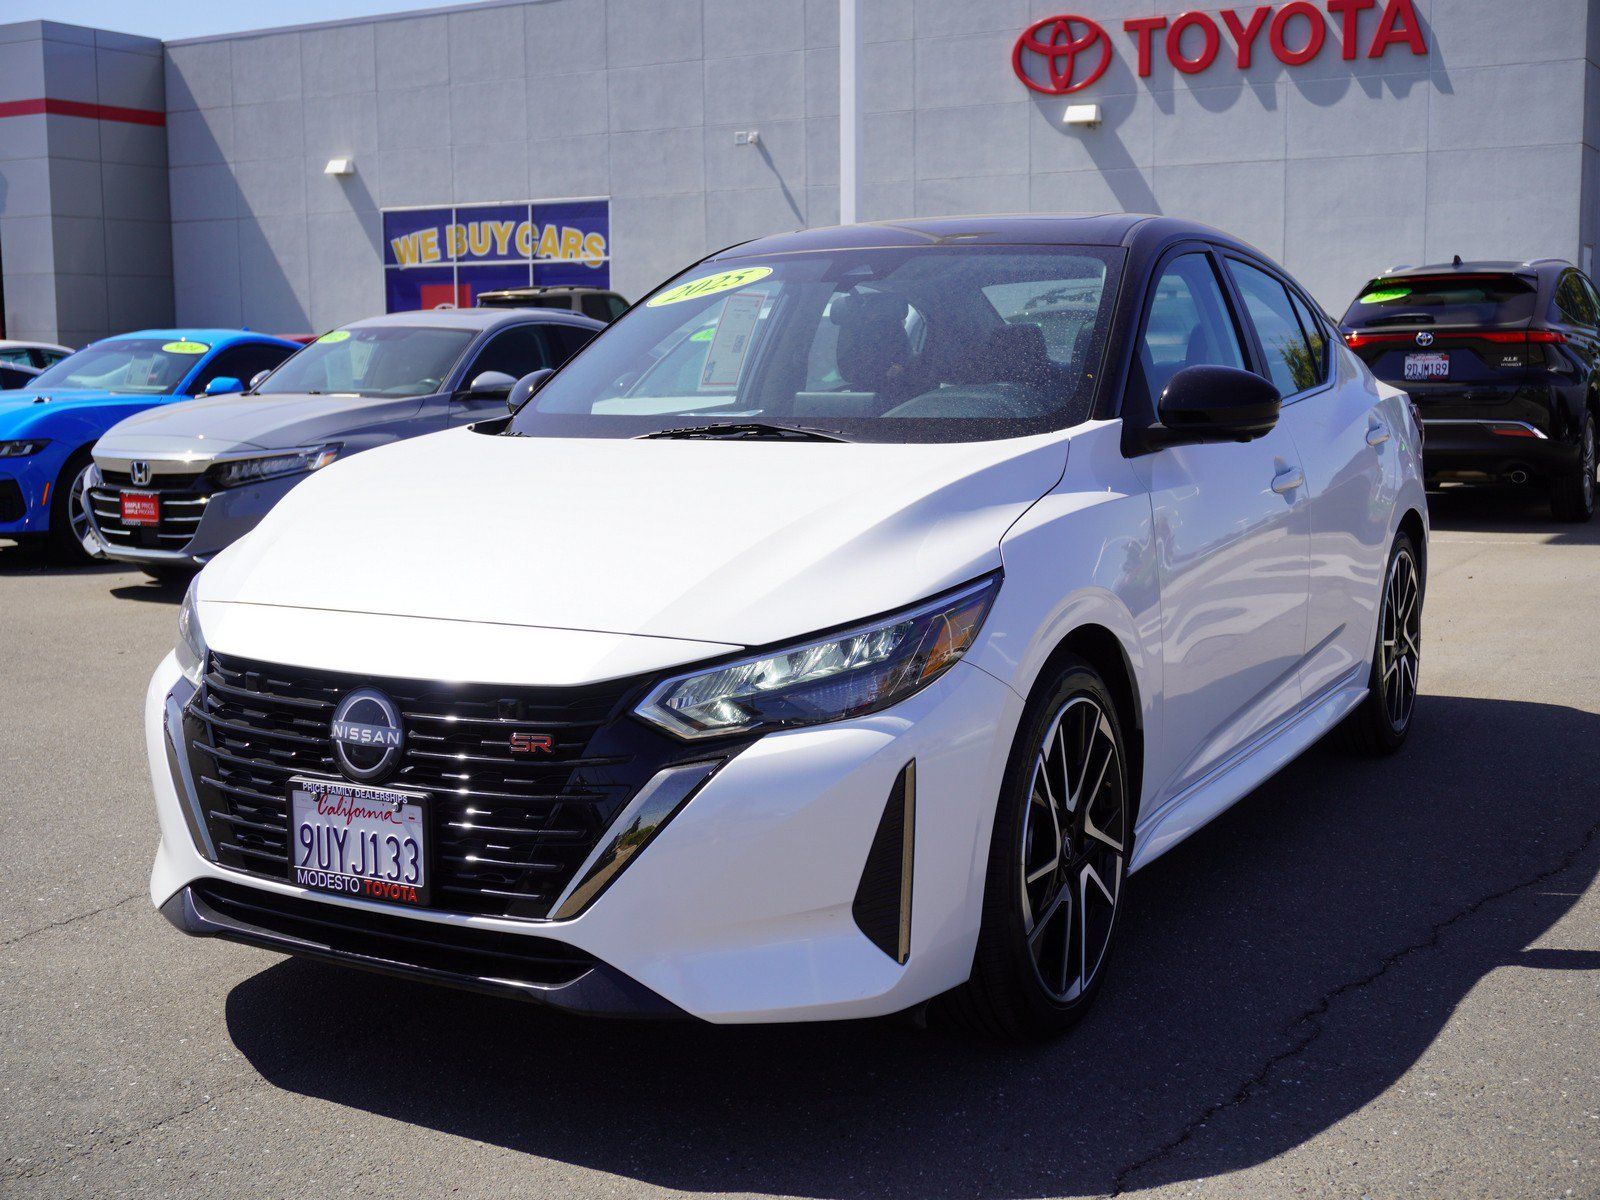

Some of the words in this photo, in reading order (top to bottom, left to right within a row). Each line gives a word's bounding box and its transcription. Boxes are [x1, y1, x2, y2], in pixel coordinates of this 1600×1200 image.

[1123, 0, 1428, 77] TOYOTA
[391, 227, 441, 270] WE
[445, 221, 516, 258] BUY
[515, 221, 606, 269] CARS
[1406, 363, 1448, 376] 9DJM189
[332, 723, 400, 745] NISSAN
[510, 732, 552, 753] SR
[302, 782, 325, 793] PRICE
[326, 784, 357, 798] FAMILY
[355, 789, 408, 804] DEALERSHIPS
[317, 791, 403, 826] California
[299, 821, 420, 885] 9UYJ133
[297, 869, 360, 893] MODESTO
[363, 879, 418, 903] TOYOTA
